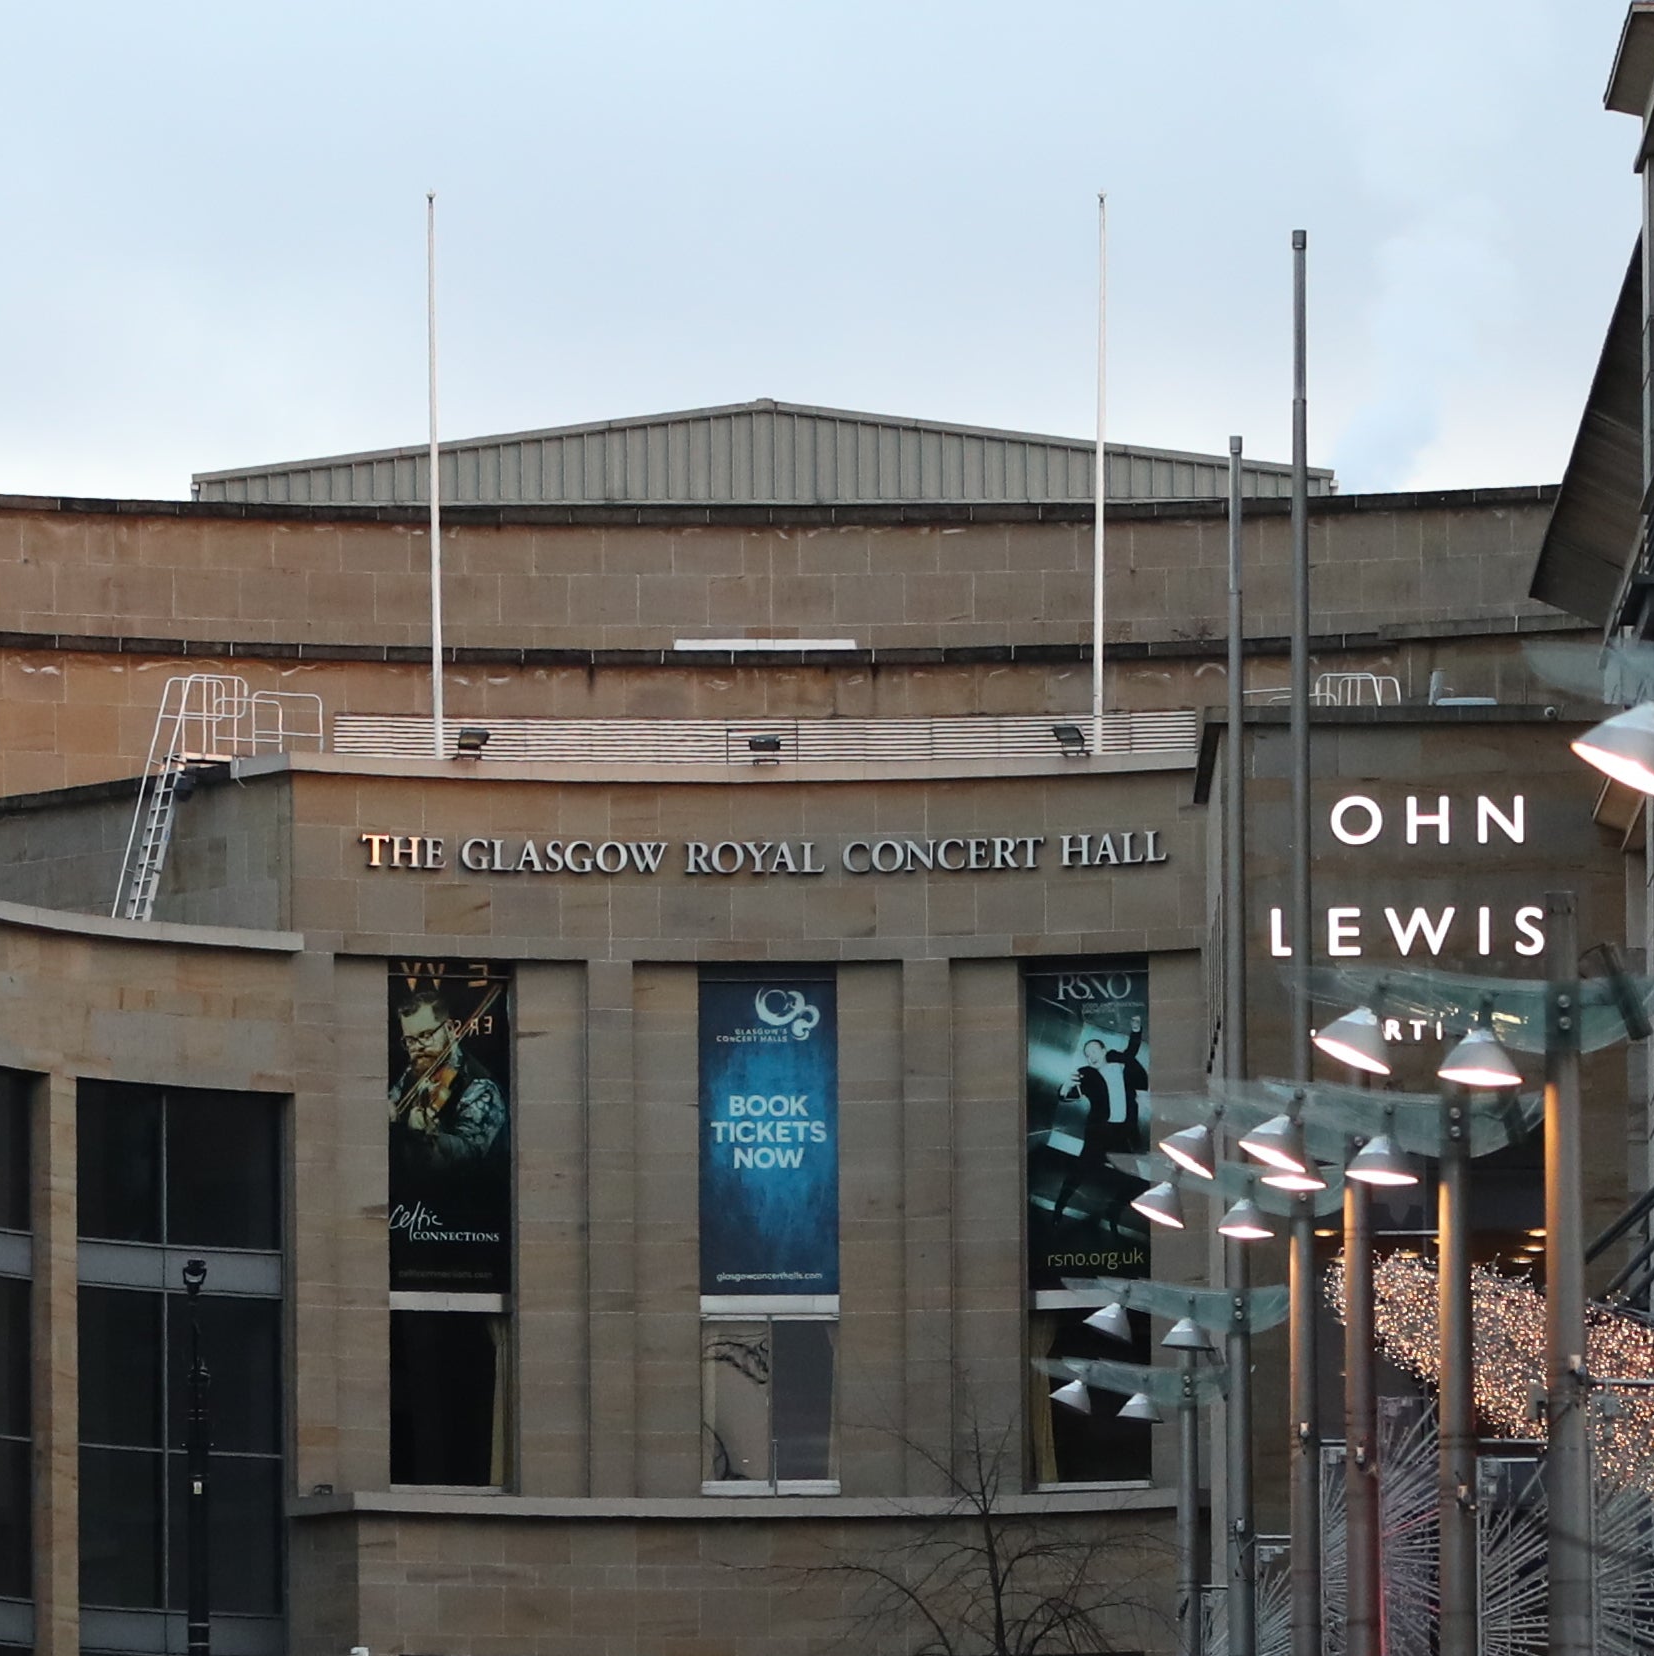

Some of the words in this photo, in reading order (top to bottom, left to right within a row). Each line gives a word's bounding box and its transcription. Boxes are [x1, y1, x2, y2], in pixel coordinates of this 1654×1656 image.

[1329, 794, 1525, 845] OHN
[359, 833, 447, 870] THE
[460, 837, 668, 873] GLASGOW
[685, 840, 825, 874] ROYAL
[841, 835, 1044, 873] CONCERT
[1060, 829, 1168, 866] HALL
[1269, 905, 1546, 958] LEWIS
[1057, 973, 1132, 1000] RSNO
[716, 1035, 757, 1043] CONCERT
[760, 1035, 788, 1043] HALLS
[728, 1095, 808, 1117] BOOK
[710, 1121, 827, 1143] TICKETS
[733, 1147, 805, 1169] NOW
[413, 1231, 500, 1242] CONNECTIONS
[1046, 1247, 1144, 1270] rsno.org.uk
[716, 1272, 823, 1283] glasgowconcerthalls.com
